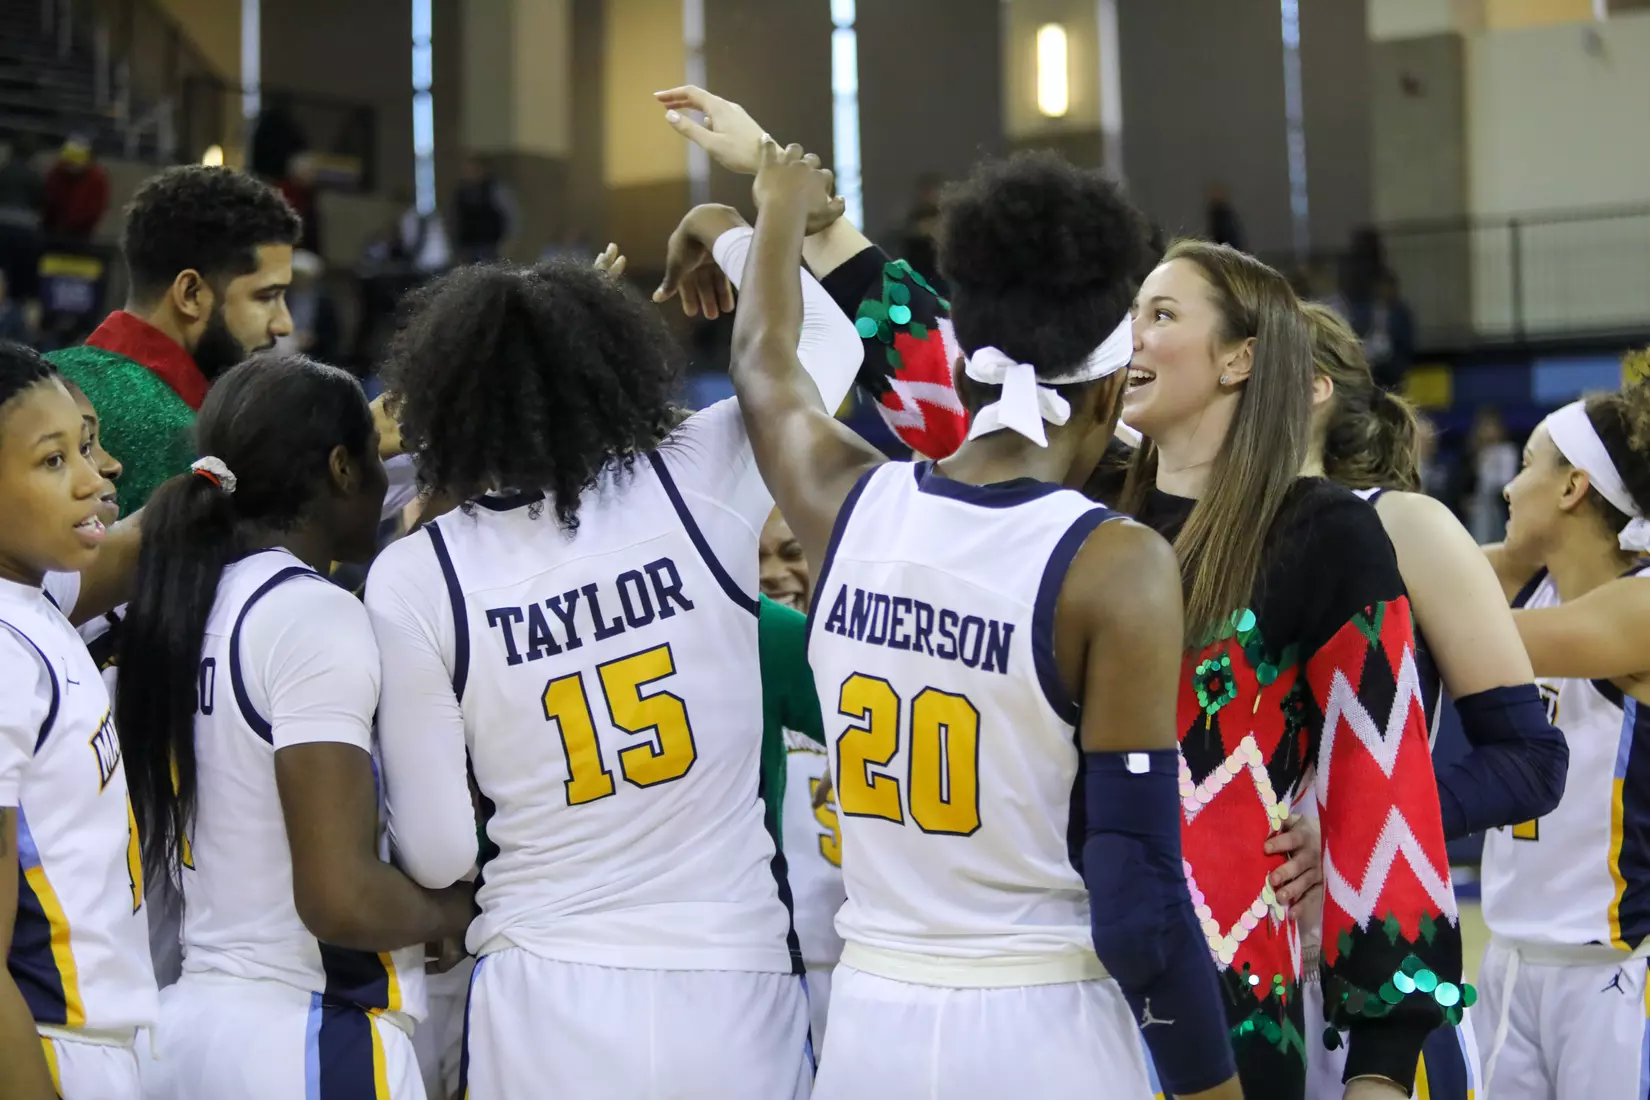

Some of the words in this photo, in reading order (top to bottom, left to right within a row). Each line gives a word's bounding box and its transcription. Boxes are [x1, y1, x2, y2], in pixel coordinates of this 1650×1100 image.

[485, 557, 695, 667] TAYLOR
[824, 584, 1016, 675] ANDERSON
[541, 642, 698, 806] 15
[836, 671, 982, 837] 20
